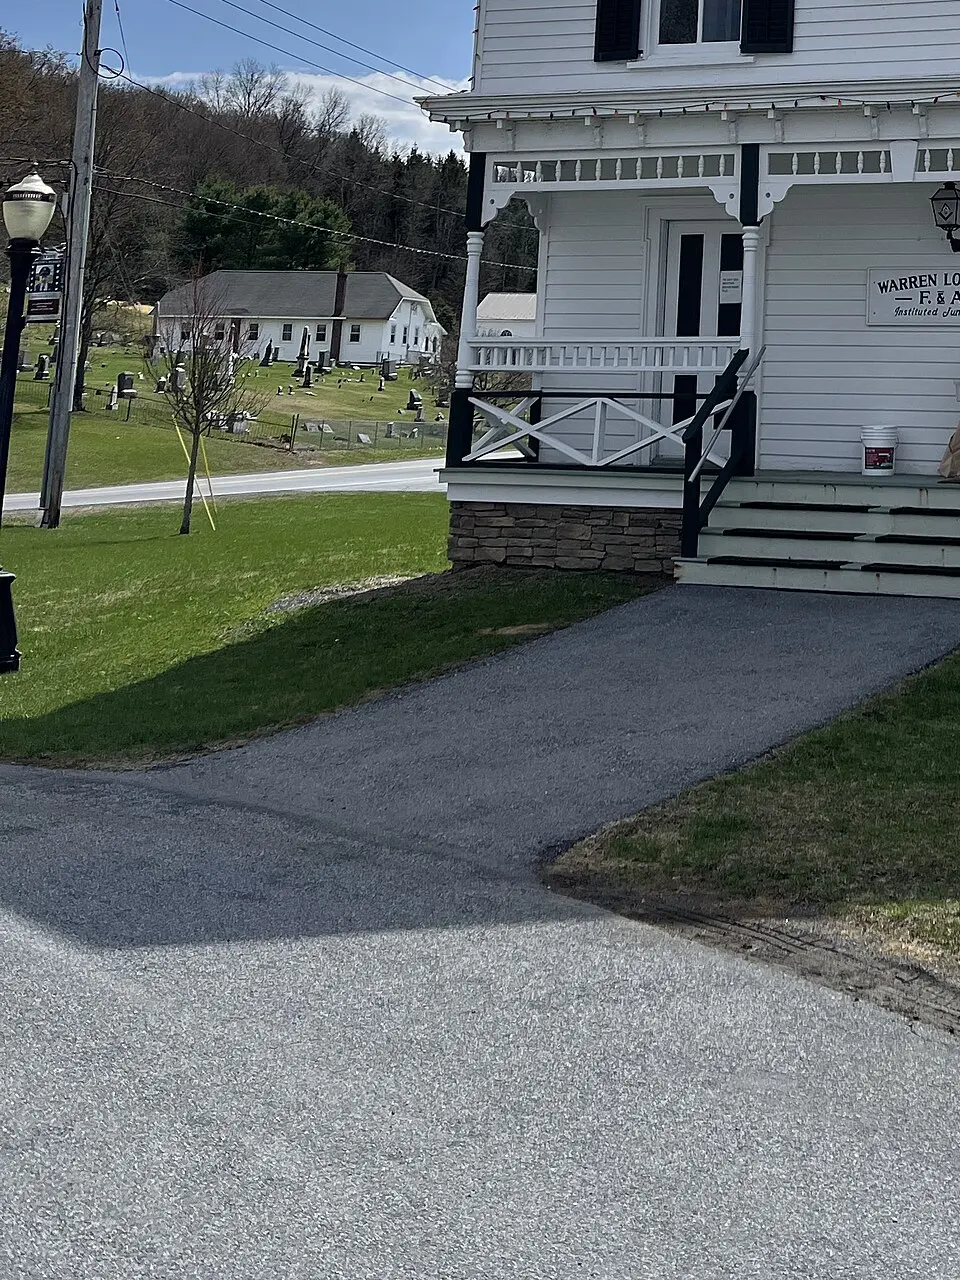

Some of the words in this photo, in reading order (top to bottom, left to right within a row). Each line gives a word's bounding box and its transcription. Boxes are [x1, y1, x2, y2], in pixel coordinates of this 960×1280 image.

[877, 273, 938, 294] WARREN
[919, 290, 932, 305] F.
[936, 290, 946, 305] &
[894, 306, 939, 317] Instituted
